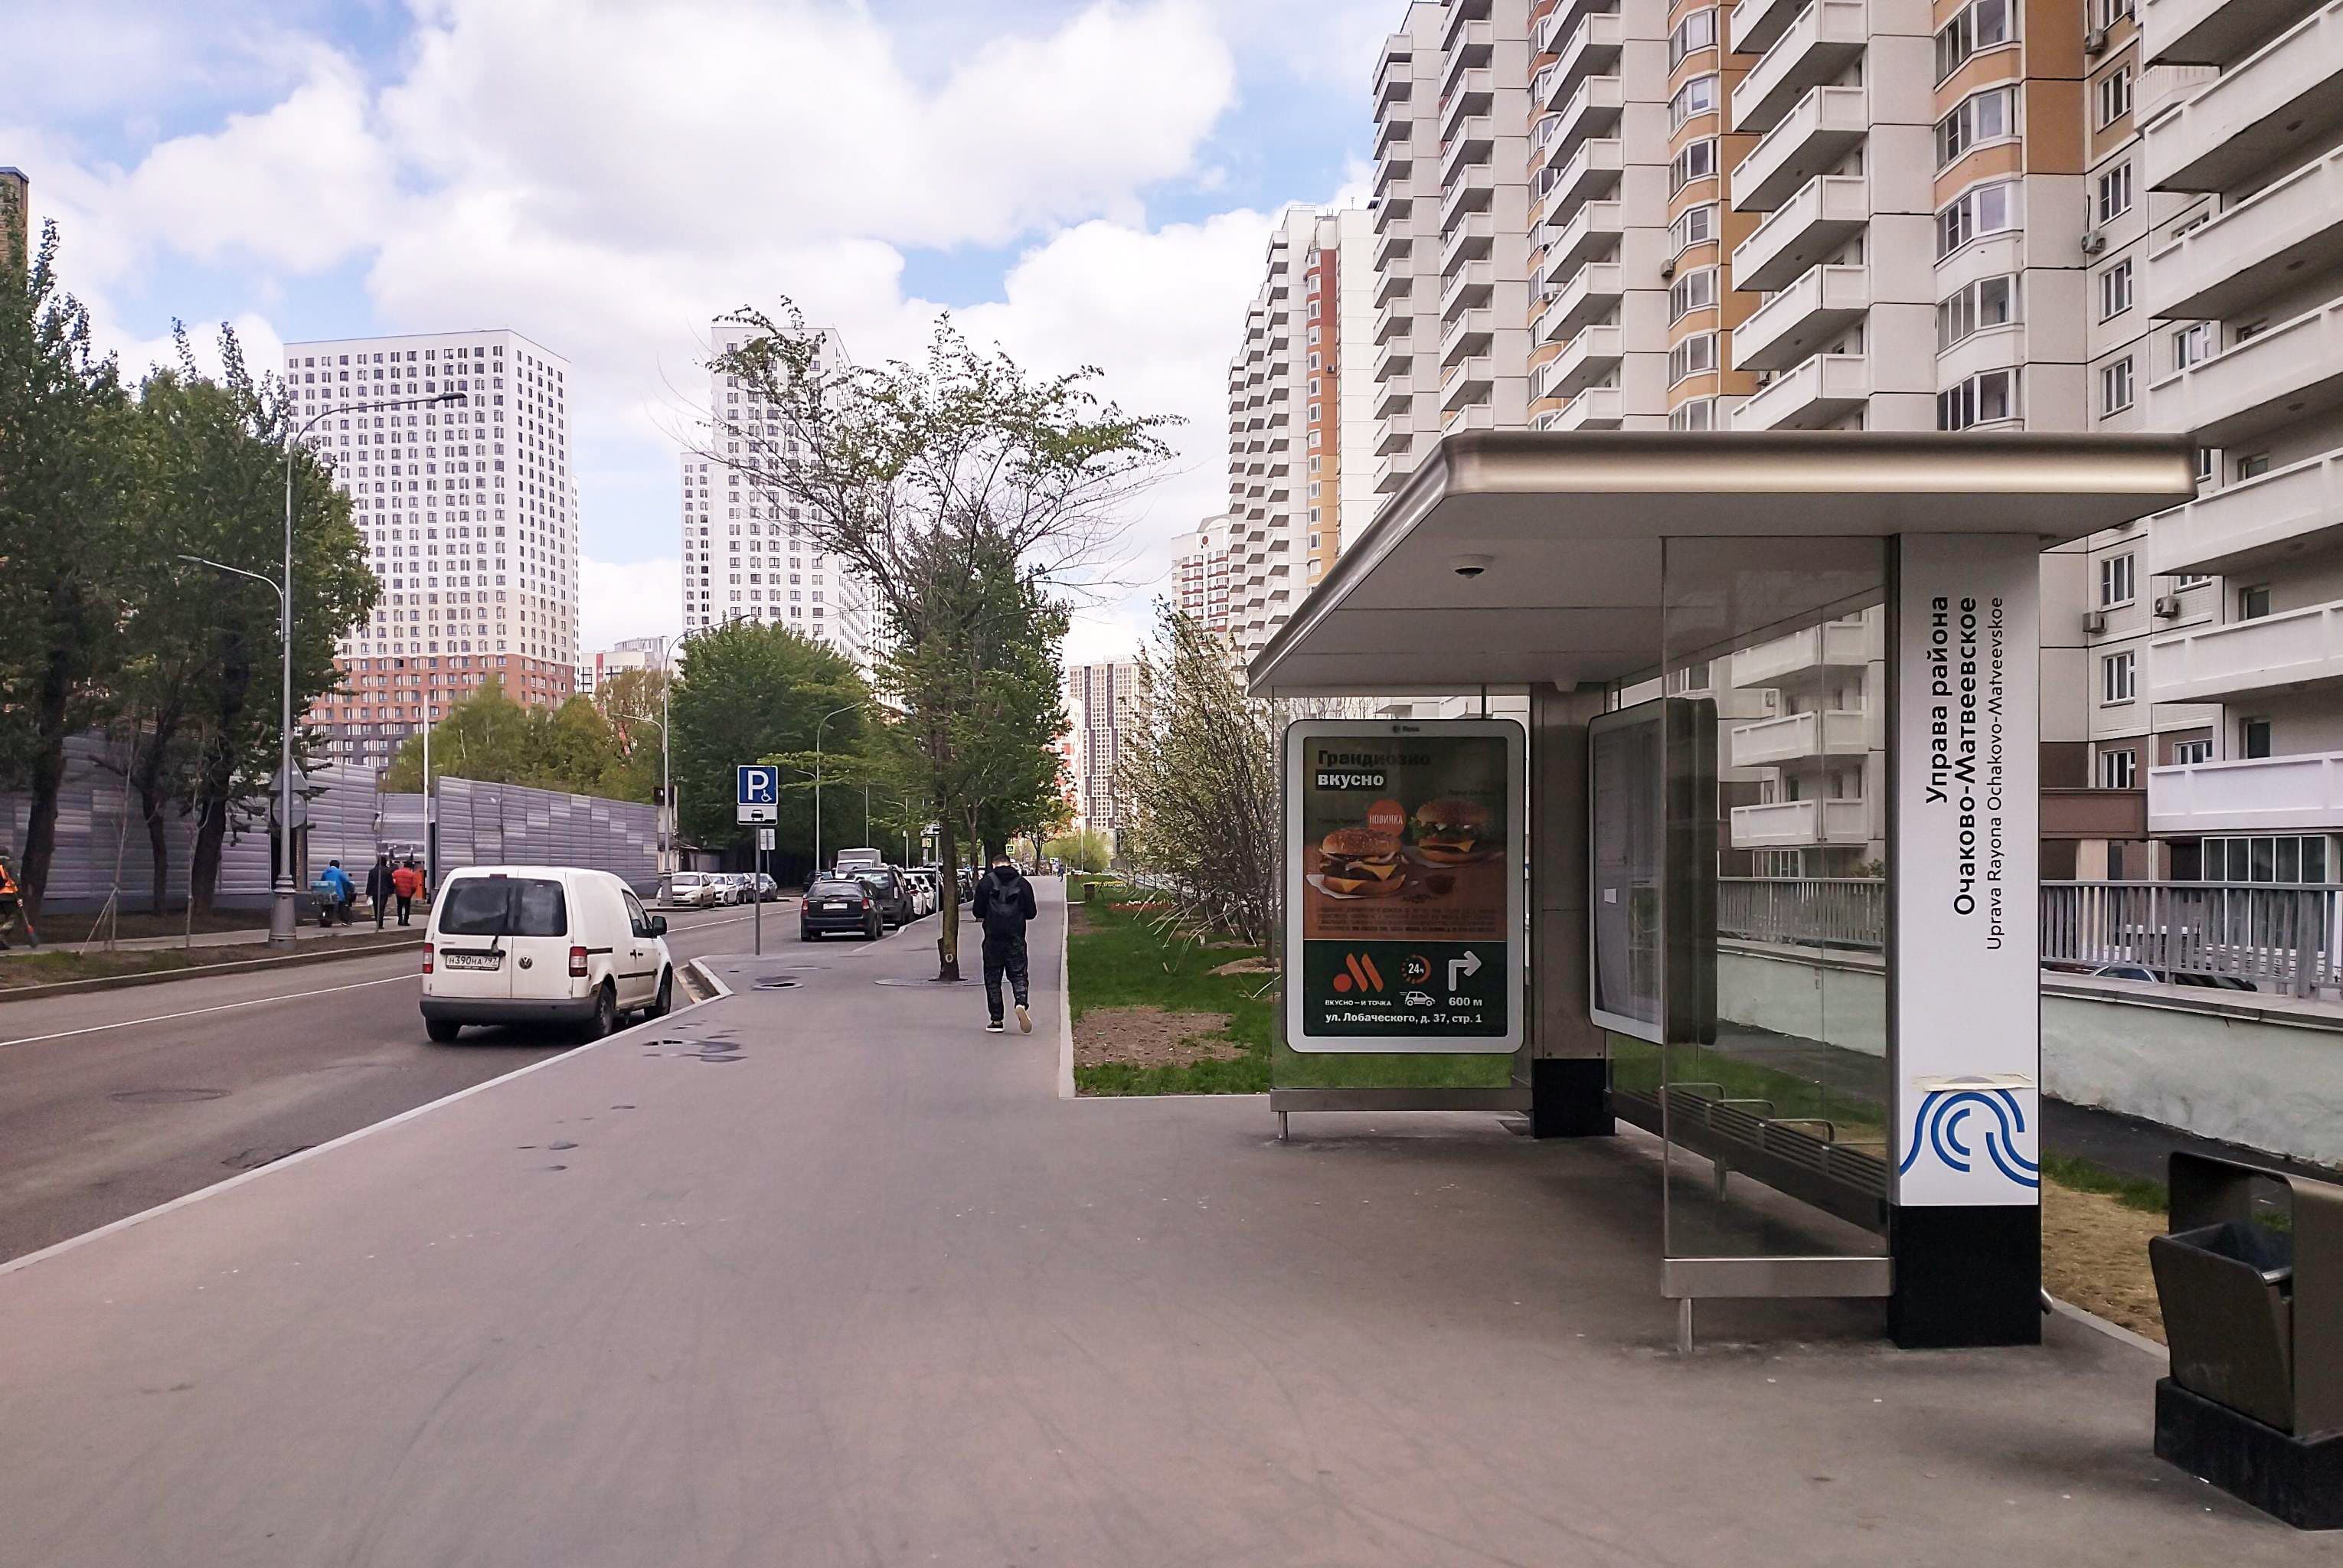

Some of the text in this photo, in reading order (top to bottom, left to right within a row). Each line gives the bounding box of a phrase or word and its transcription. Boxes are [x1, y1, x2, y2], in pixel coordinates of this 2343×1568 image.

[1926, 596, 1953, 804] Управа района
[1318, 750, 1431, 767] Грандиозно
[1953, 596, 1977, 916] Очаково-Матвеевское
[1317, 773, 1384, 789] вкусно
[1987, 596, 2005, 950] Uprava Rayona Ochakovo-Matveevskoe
[747, 770, 769, 801] P
[1369, 814, 1404, 825] НОВИНКА
[1449, 997, 1471, 1007] 600
[1325, 1013, 1341, 1024] ул.
[1420, 1014, 1430, 1024] д.
[1433, 1014, 1449, 1024] 37,
[1452, 1014, 1473, 1024] стр.
[1475, 1014, 1482, 1023] 1
